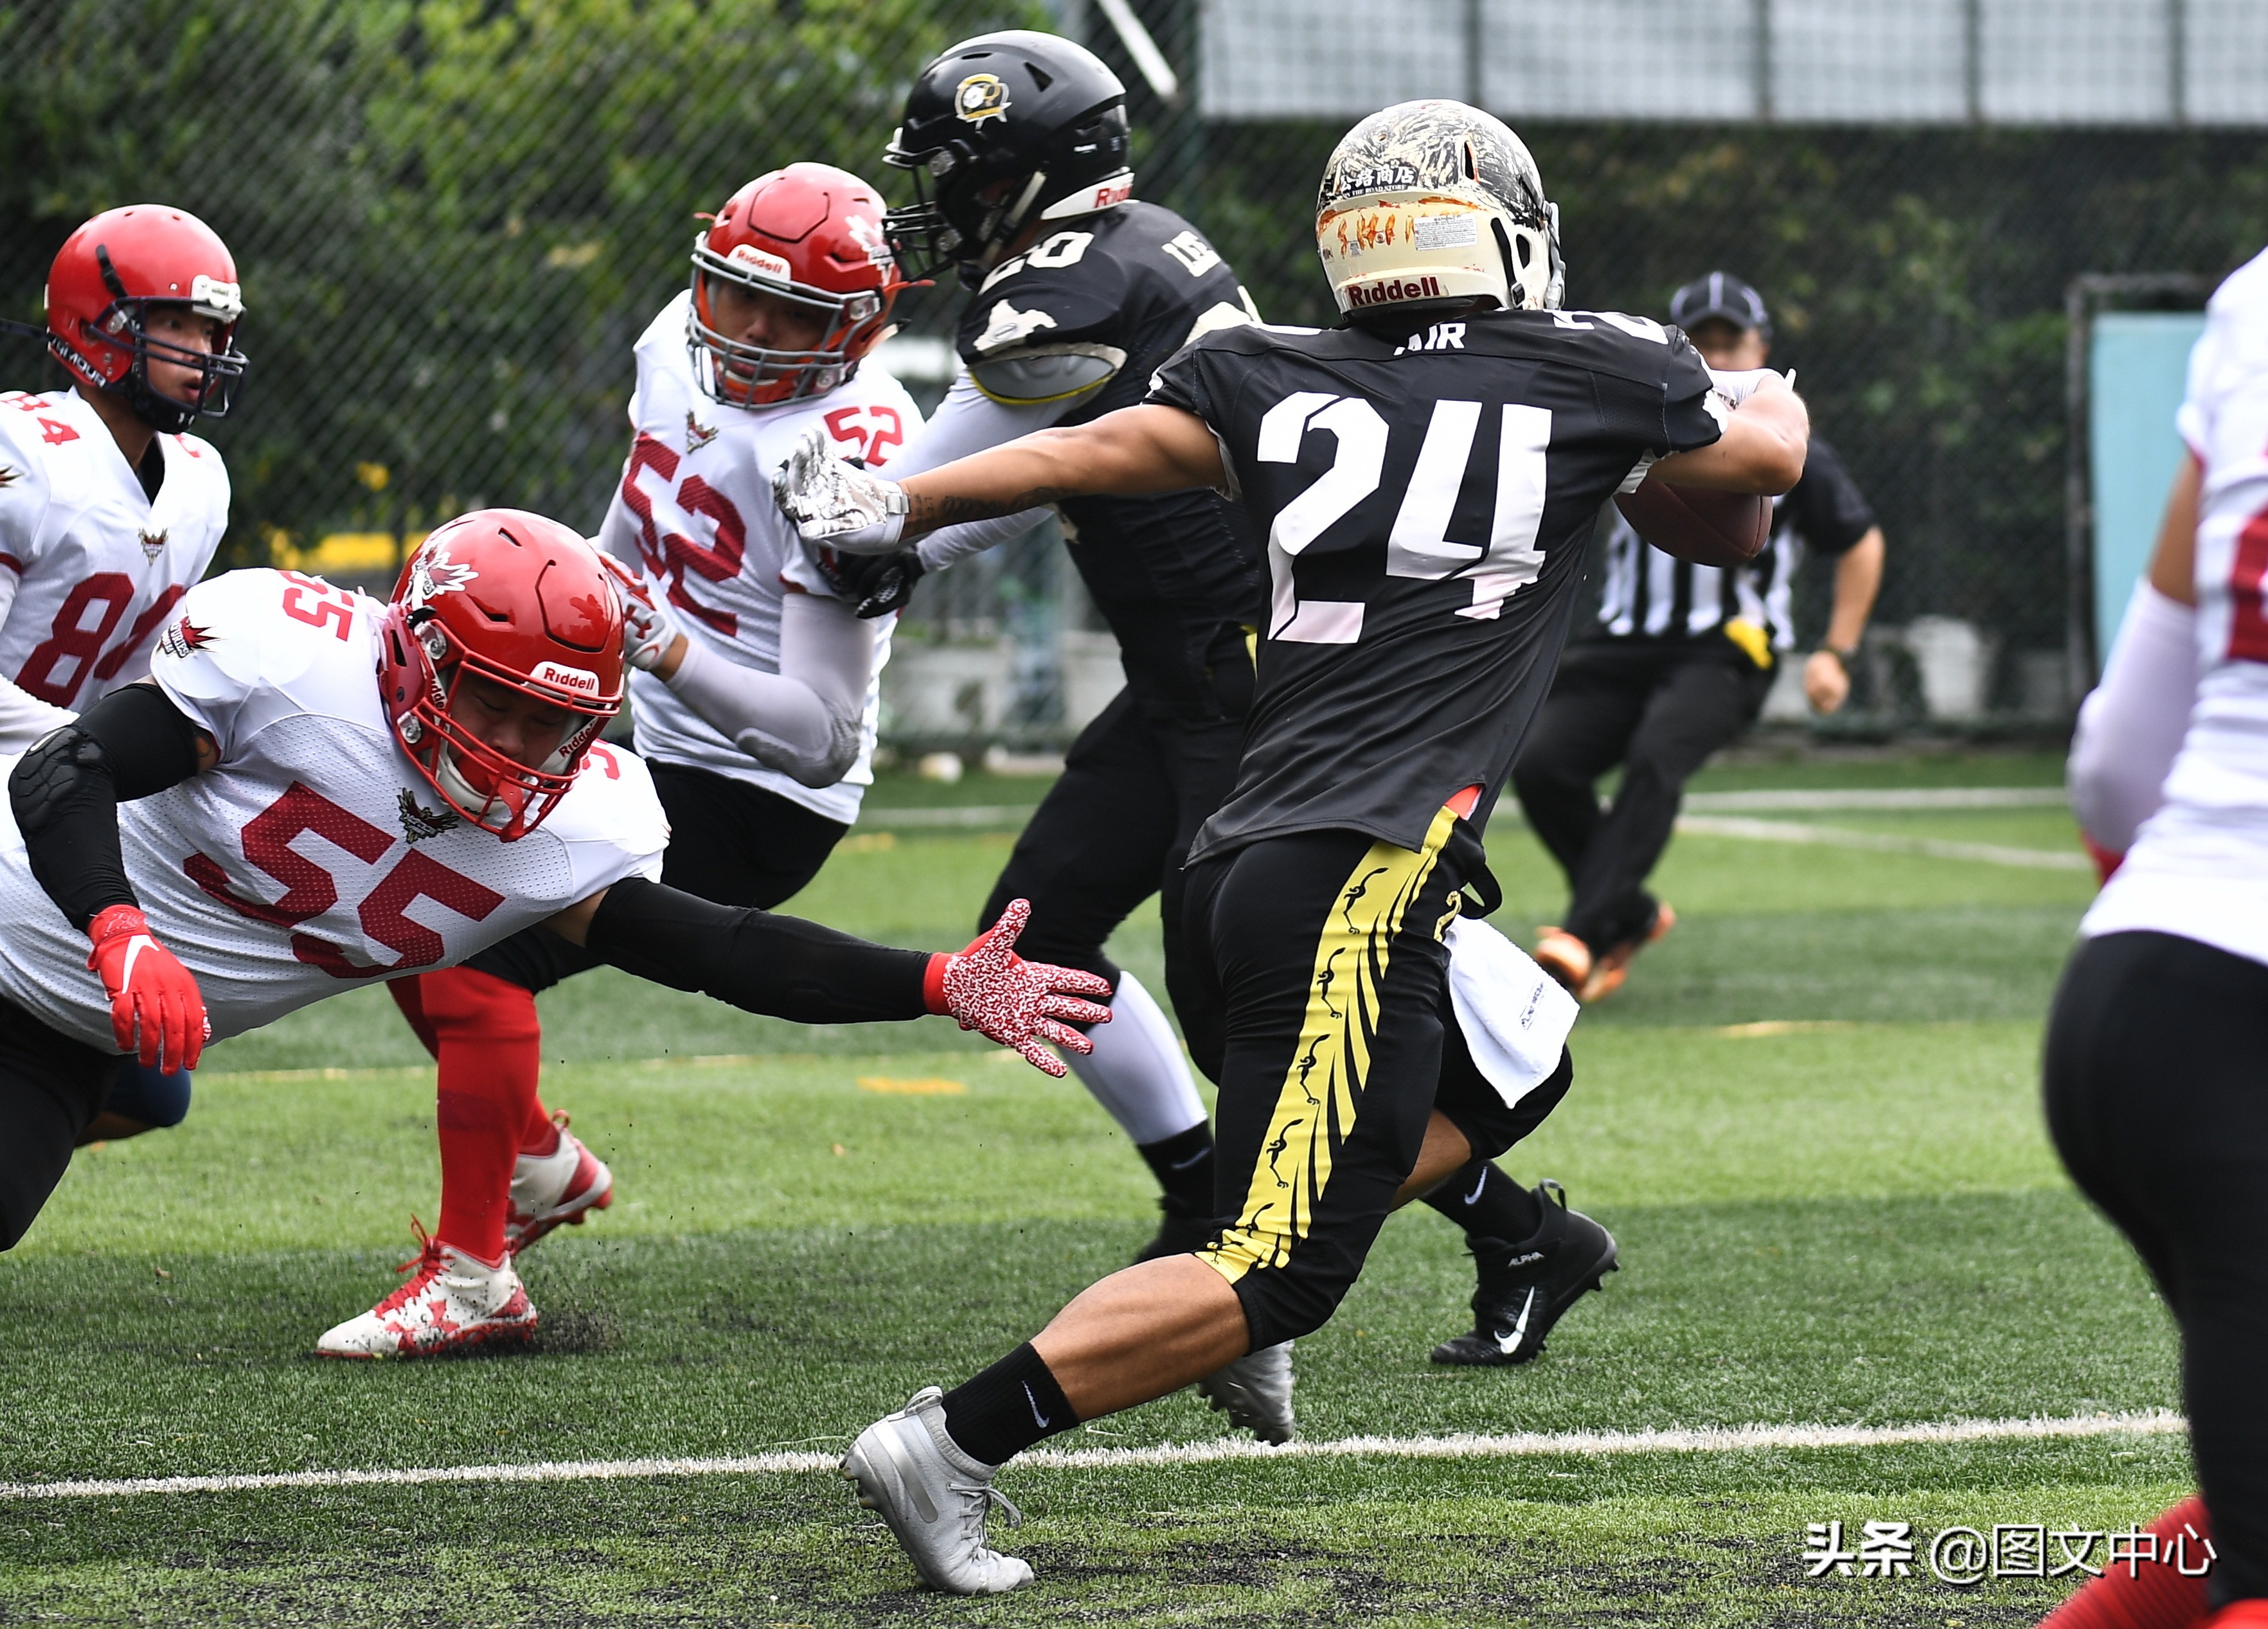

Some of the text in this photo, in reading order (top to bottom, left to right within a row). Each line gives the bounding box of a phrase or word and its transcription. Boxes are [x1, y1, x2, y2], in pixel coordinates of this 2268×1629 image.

[737, 250, 783, 274] Riddell
[1348, 276, 1440, 306] Riddell
[823, 406, 904, 467] 52
[621, 431, 747, 638] 52
[1257, 391, 1553, 644] 24
[543, 667, 596, 690] Riddell
[183, 780, 506, 979] 55
